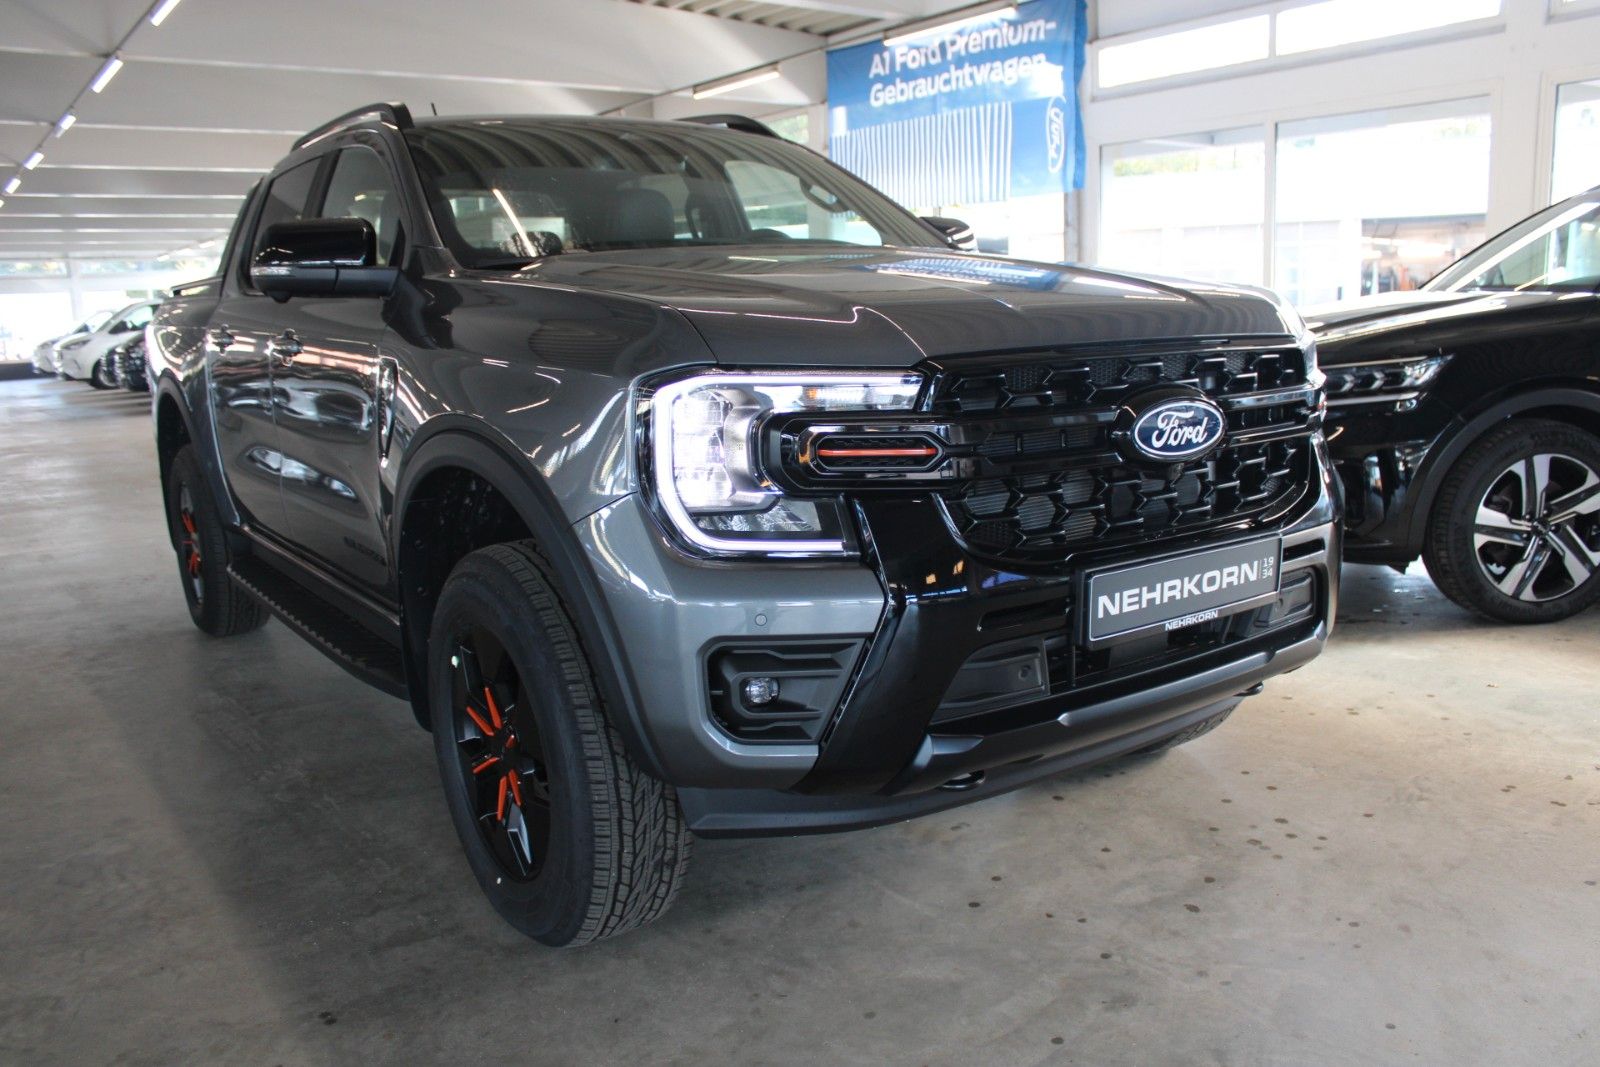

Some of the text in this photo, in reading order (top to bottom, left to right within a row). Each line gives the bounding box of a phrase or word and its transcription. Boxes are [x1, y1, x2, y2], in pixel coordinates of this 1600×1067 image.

[869, 19, 1057, 78] A1 Ford Premium-
[869, 53, 1047, 107] Gebrauchtwagen
[1152, 410, 1209, 448] Ford
[1097, 560, 1259, 618] NEHRKORN
[1165, 609, 1219, 631] NEHRKORN
